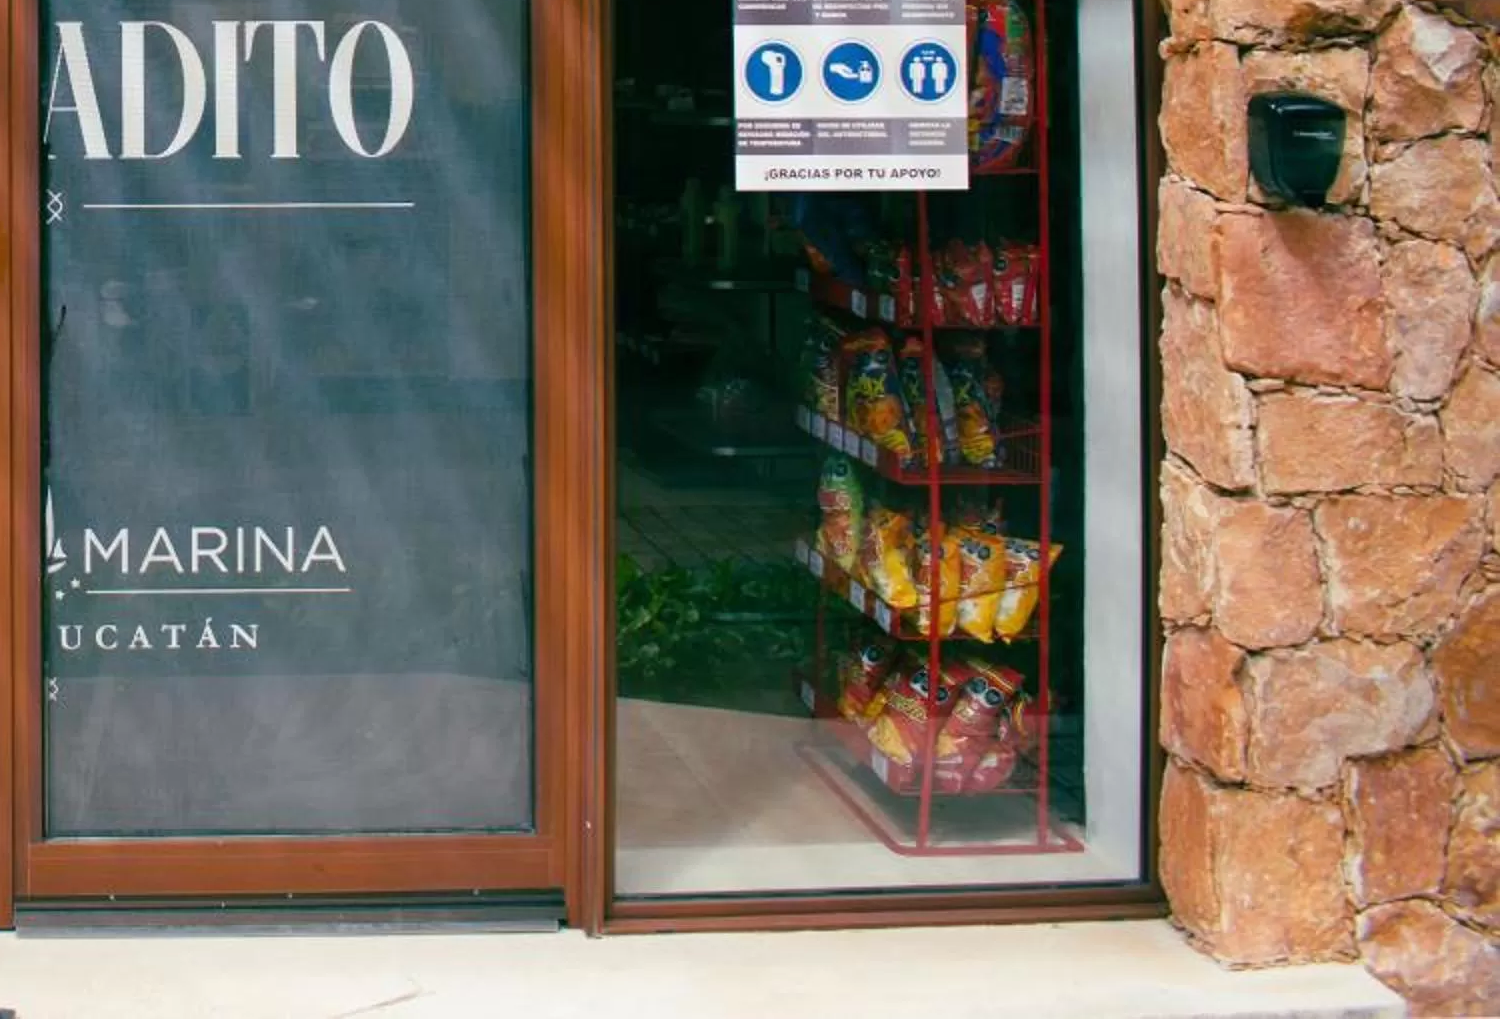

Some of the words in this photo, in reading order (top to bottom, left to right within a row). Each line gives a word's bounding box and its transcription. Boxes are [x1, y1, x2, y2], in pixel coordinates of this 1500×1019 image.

[764, 168, 831, 181] ¡GRACIAS
[835, 168, 863, 179] POR
[867, 168, 886, 179] TU
[890, 168, 941, 179] APOYO!
[83, 525, 347, 574] MARINA
